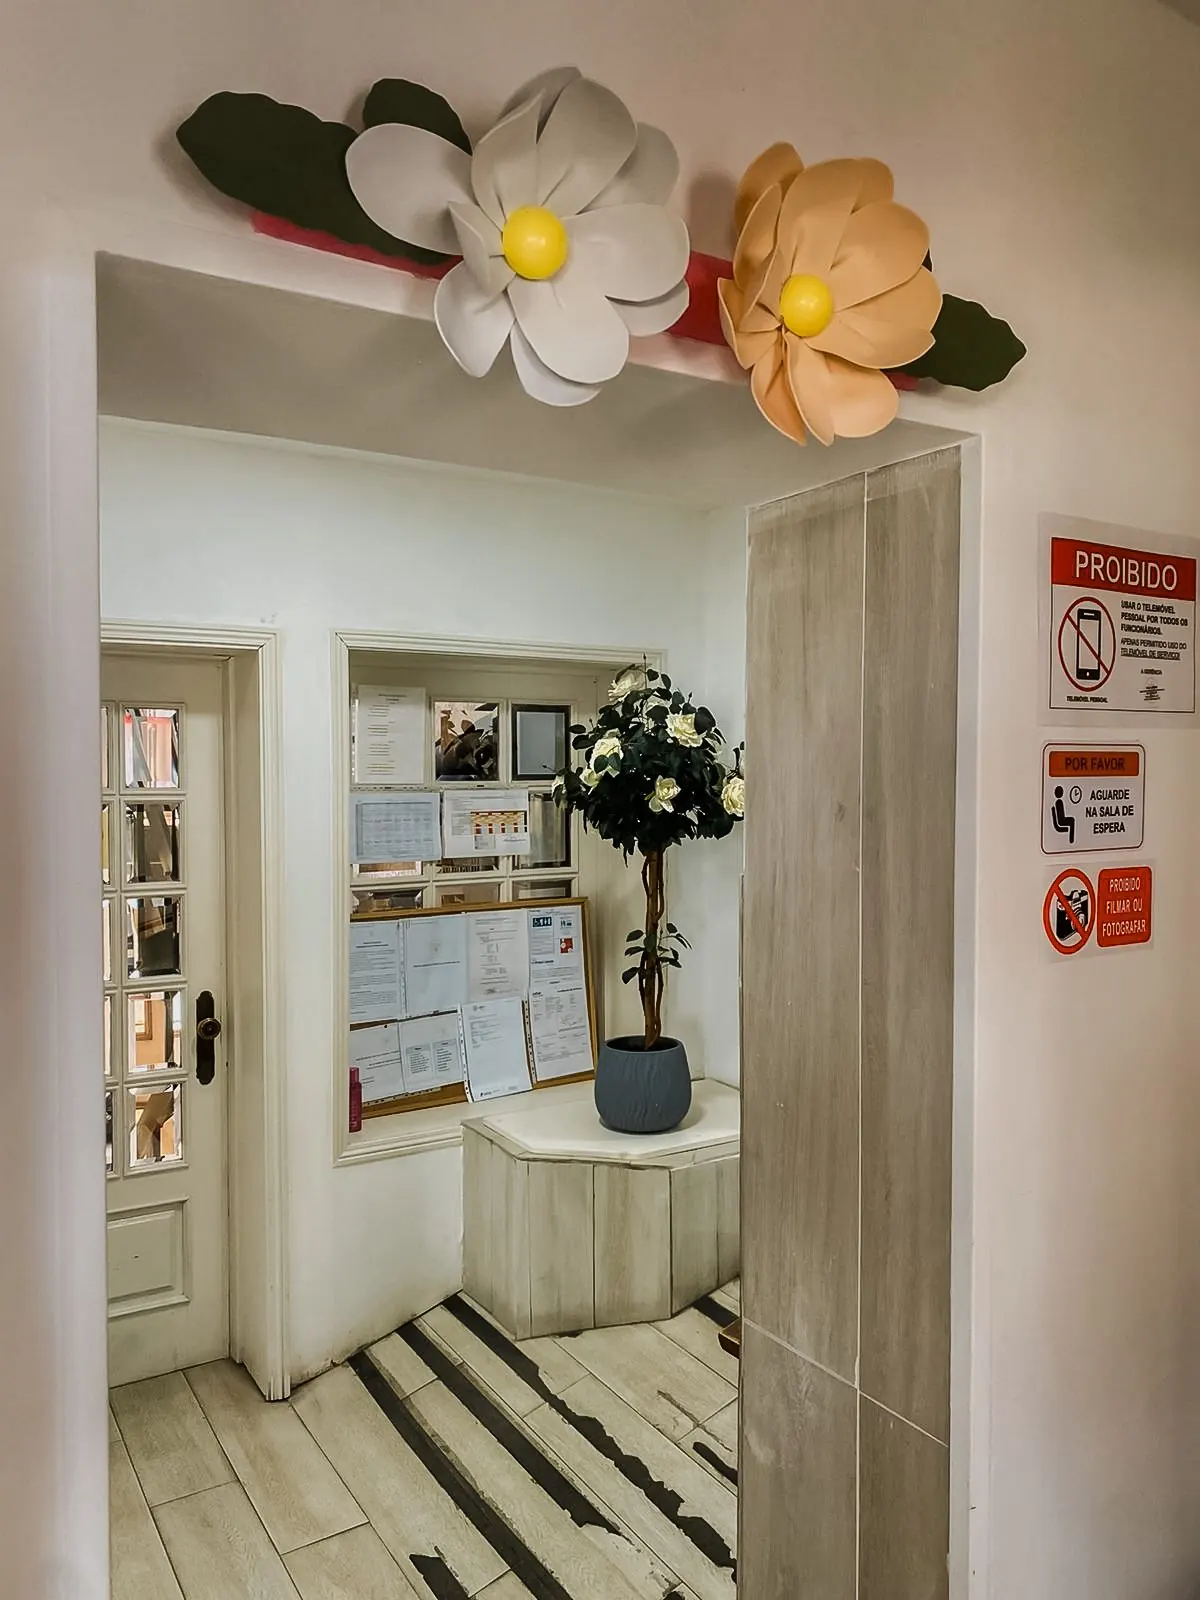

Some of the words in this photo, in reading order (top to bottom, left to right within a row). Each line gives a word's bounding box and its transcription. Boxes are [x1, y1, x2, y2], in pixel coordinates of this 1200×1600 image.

[1075, 550, 1177, 591] PROIBIDO
[1147, 615, 1158, 624] POR
[1160, 616, 1179, 625] TODOS
[1065, 757, 1087, 770] POR
[1091, 757, 1125, 770] FAVOR
[1090, 789, 1130, 801] AGUARDE
[1085, 806, 1099, 818] NA
[1099, 805, 1121, 817] SALA
[1121, 805, 1134, 817] DE
[1093, 822, 1125, 834] ESPERA
[1109, 876, 1141, 893] PROIBIDO
[1106, 899, 1131, 914] FILMAR
[1133, 898, 1143, 912] OU
[1102, 919, 1146, 937] FOTOGRAFAR
